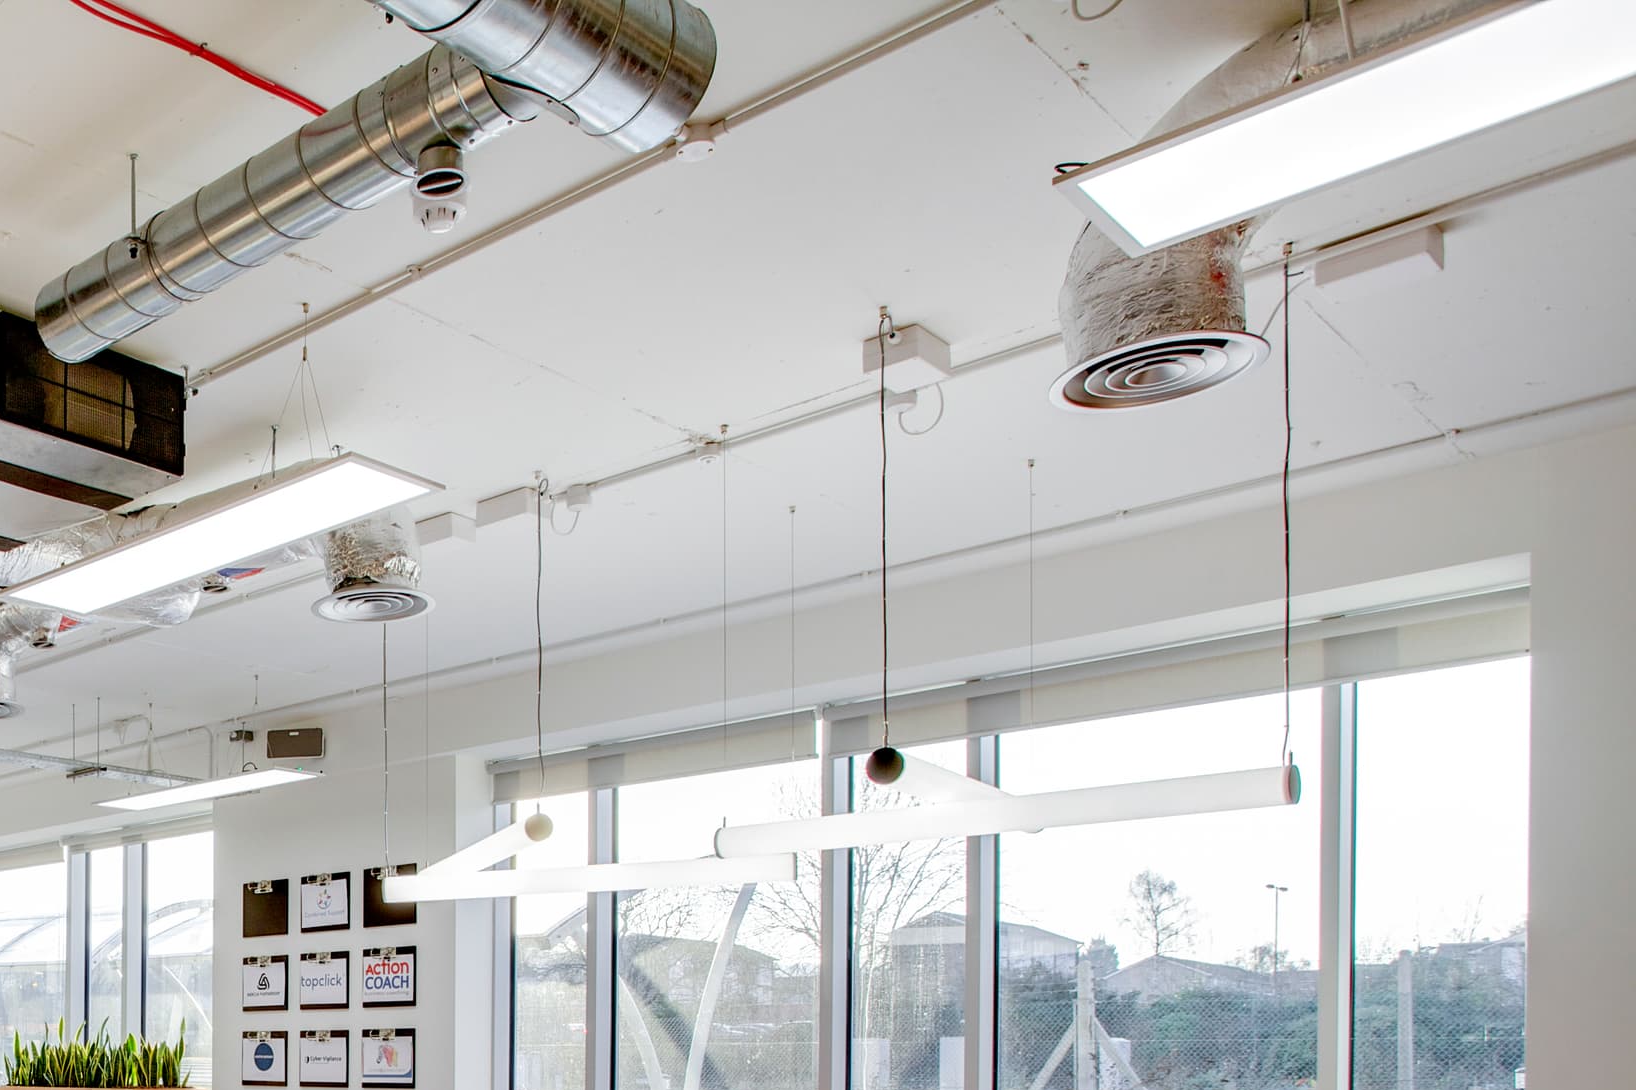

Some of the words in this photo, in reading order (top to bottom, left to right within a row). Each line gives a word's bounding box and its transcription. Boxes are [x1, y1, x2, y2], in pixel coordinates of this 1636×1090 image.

[365, 959, 410, 976] Action
[300, 973, 342, 990] topclick
[365, 975, 410, 990] COACH
